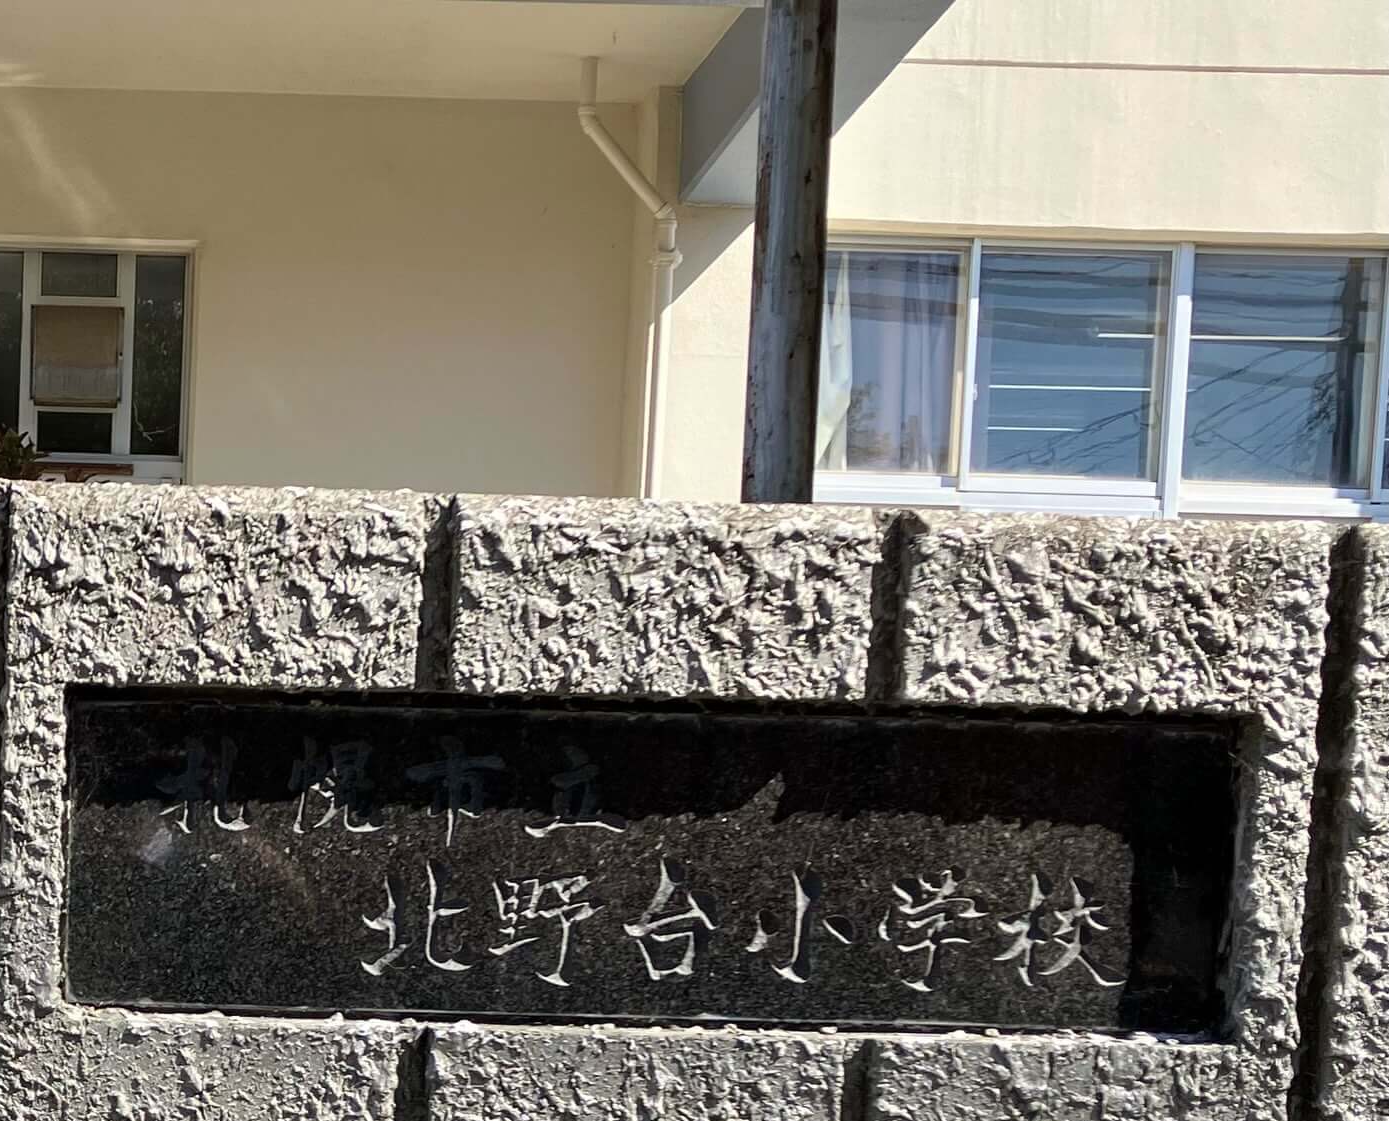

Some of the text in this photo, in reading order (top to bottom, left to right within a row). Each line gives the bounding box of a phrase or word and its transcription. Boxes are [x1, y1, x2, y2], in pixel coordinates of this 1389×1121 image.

[360, 852, 1128, 992] 北野台小学校
